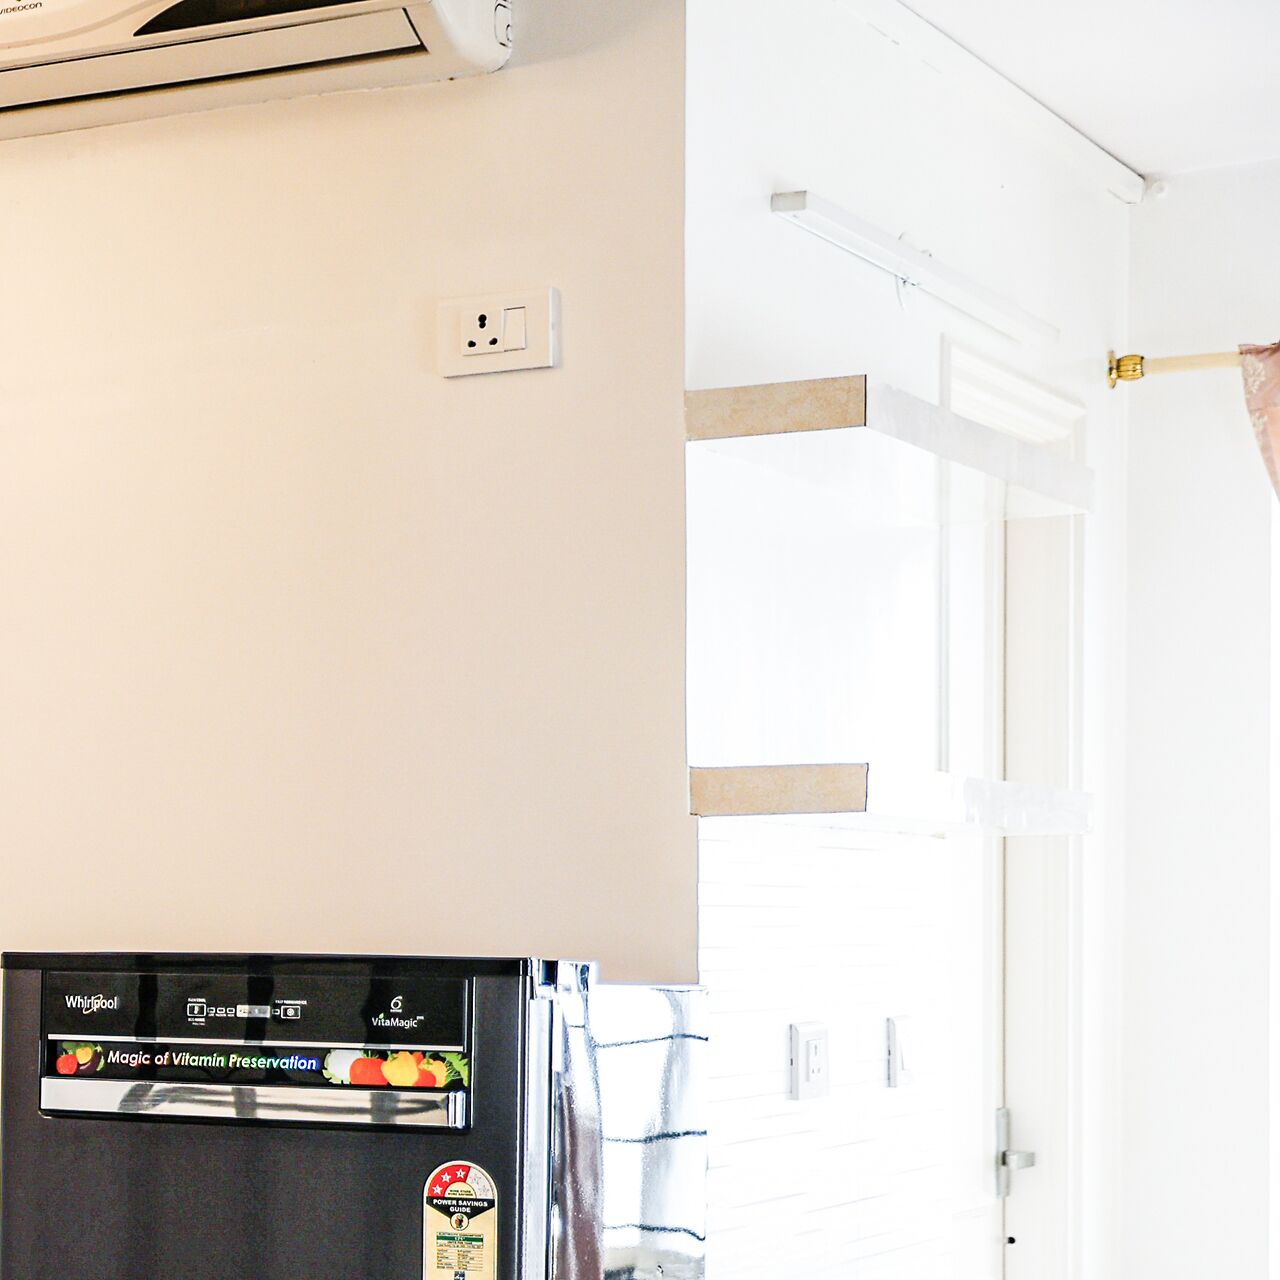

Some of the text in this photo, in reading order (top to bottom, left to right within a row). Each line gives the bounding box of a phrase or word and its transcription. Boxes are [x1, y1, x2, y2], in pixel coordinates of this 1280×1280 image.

[65, 994, 118, 1014] Whirlpool
[371, 1015, 418, 1029] VitaMagic
[107, 1050, 317, 1070] Magic of Vitamin Preservation
